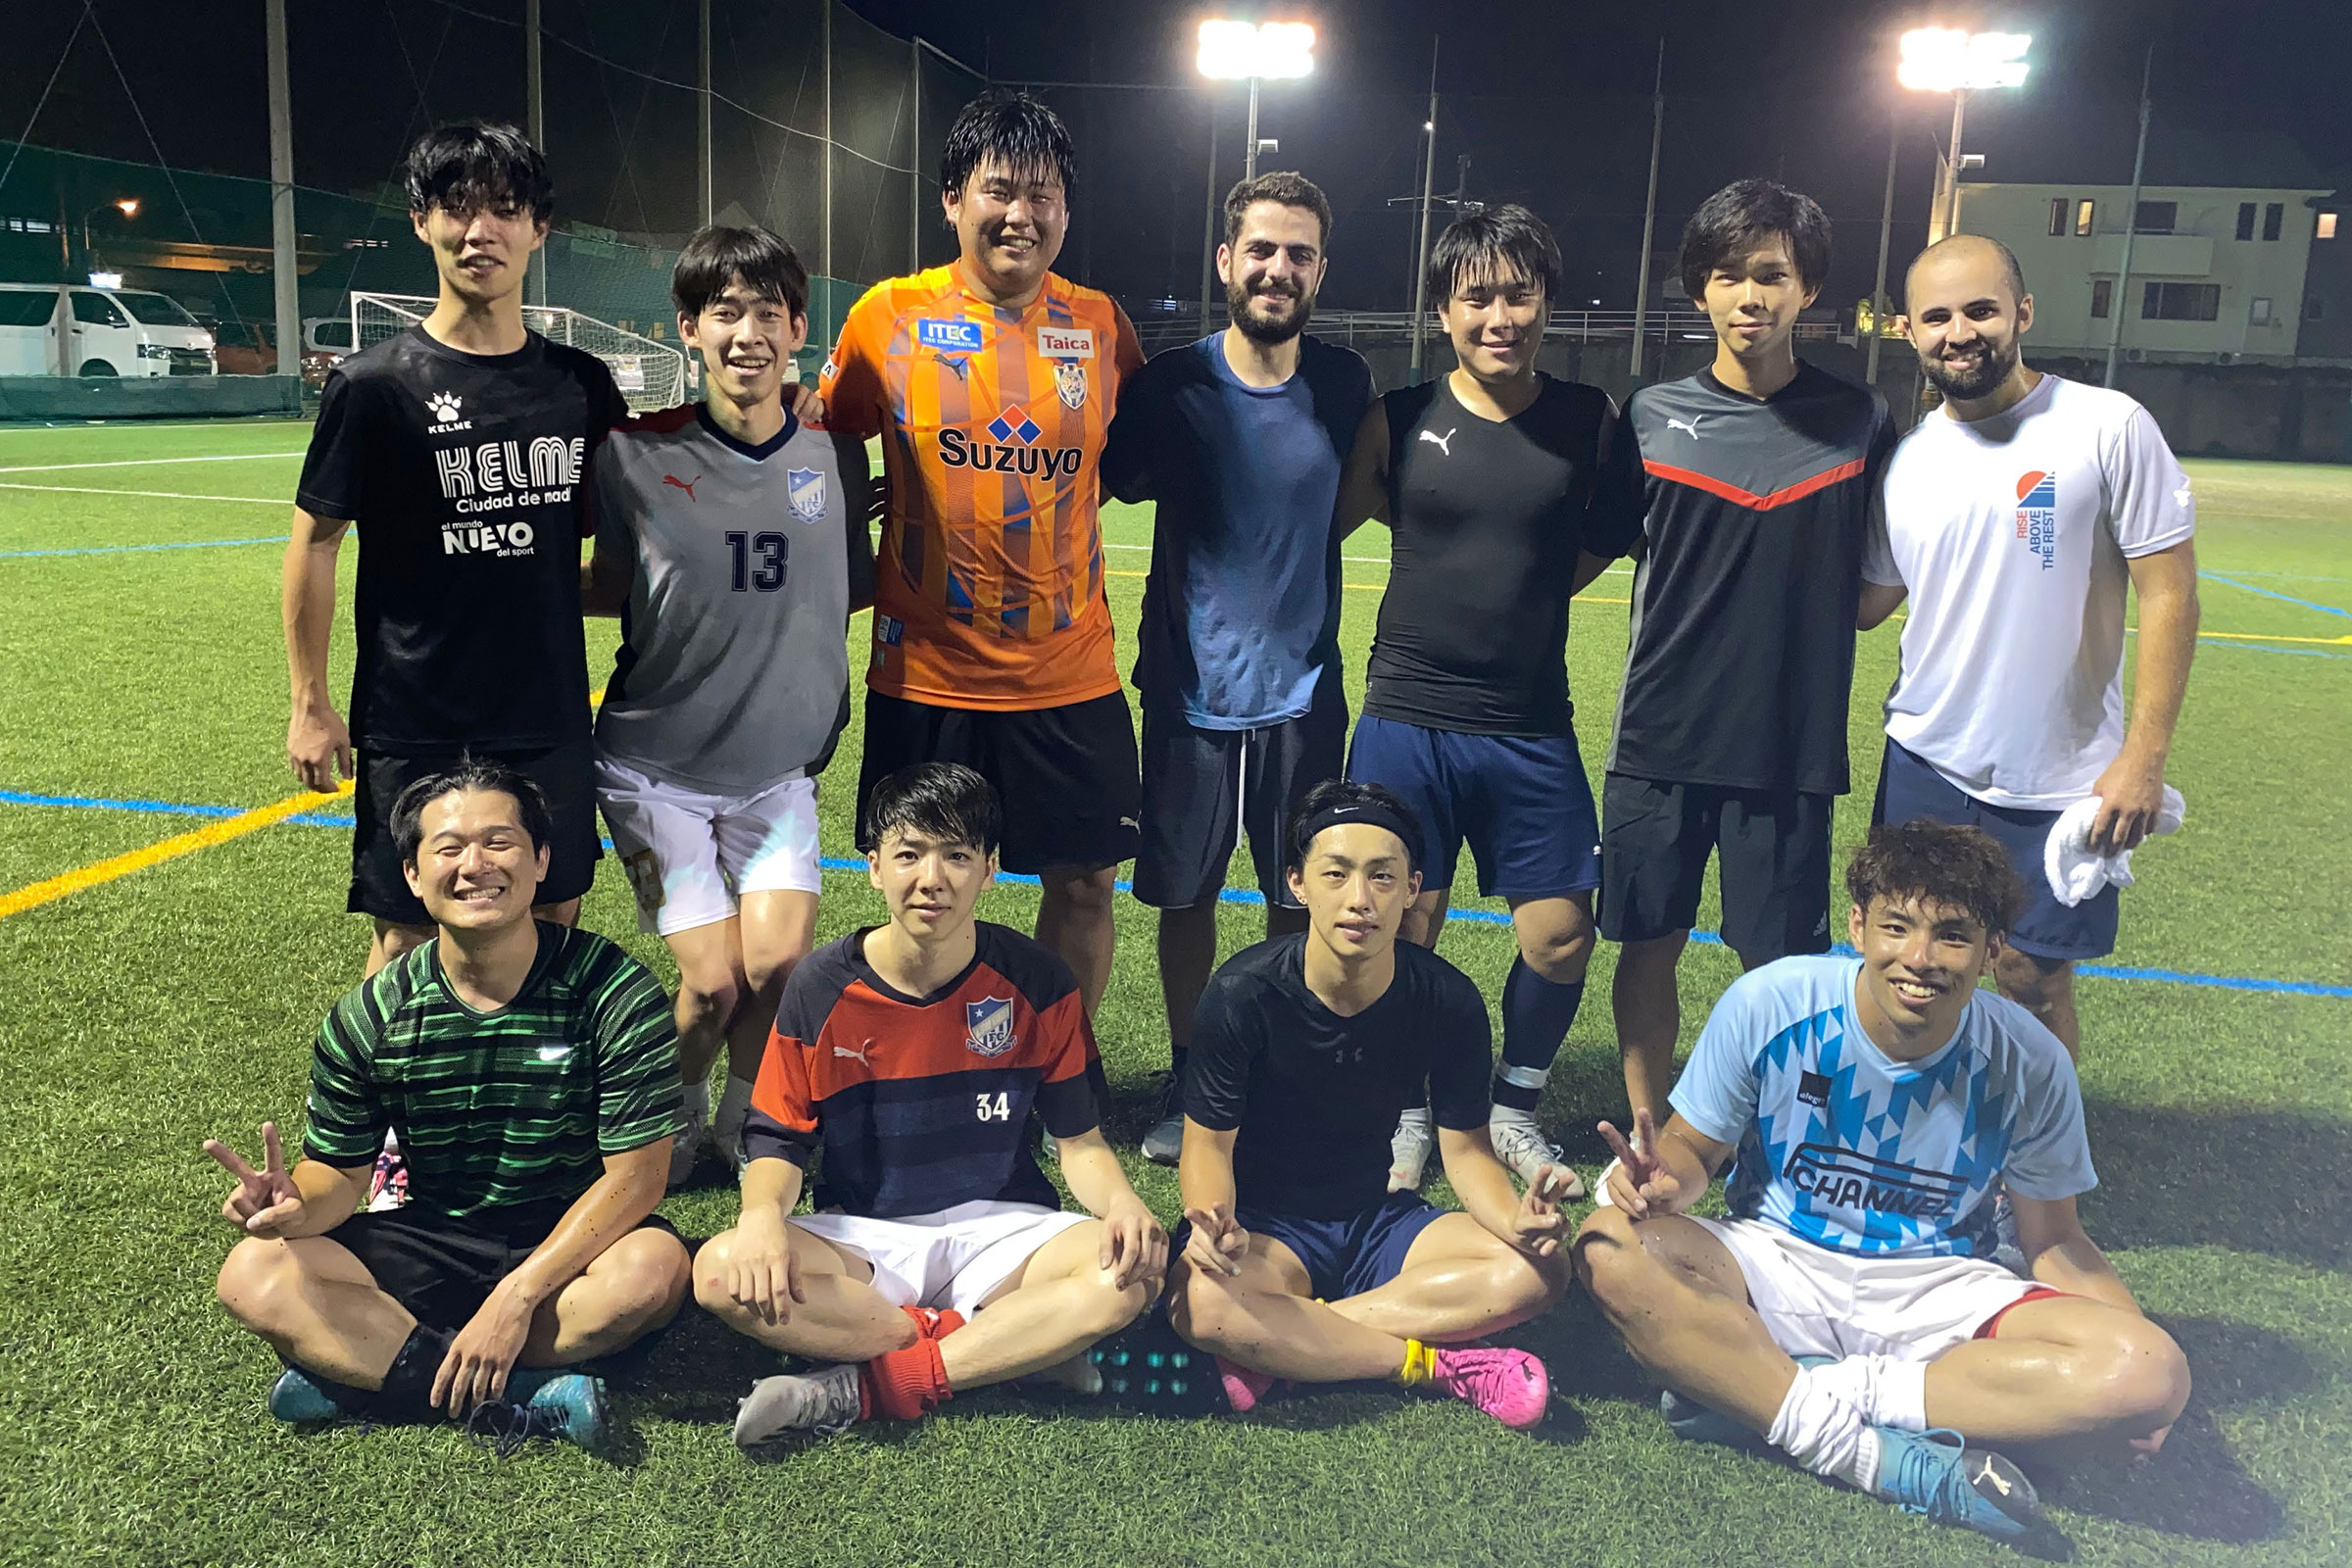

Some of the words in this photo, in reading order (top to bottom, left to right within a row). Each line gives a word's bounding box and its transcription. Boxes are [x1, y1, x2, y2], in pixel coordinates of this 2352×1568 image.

[928, 323, 971, 341] ITEC
[1042, 334, 1090, 351] Taica
[428, 420, 472, 434] KELME
[435, 436, 585, 498] KELME
[937, 427, 1082, 482] Suzuyo
[456, 491, 514, 513] Ciudad
[518, 490, 540, 506] de
[441, 522, 451, 531] el
[452, 519, 483, 529] mundo
[443, 521, 534, 555] NUEVO
[2016, 511, 2028, 538] RISE
[2030, 510, 2040, 555] ABOVE
[2042, 510, 2054, 543] REST
[497, 548, 510, 557] del
[513, 546, 534, 557] sport
[725, 530, 789, 592] 13
[2042, 546, 2054, 570] THE
[975, 1092, 1010, 1121] 34
[1792, 1165, 1956, 1217] CHANNEL
